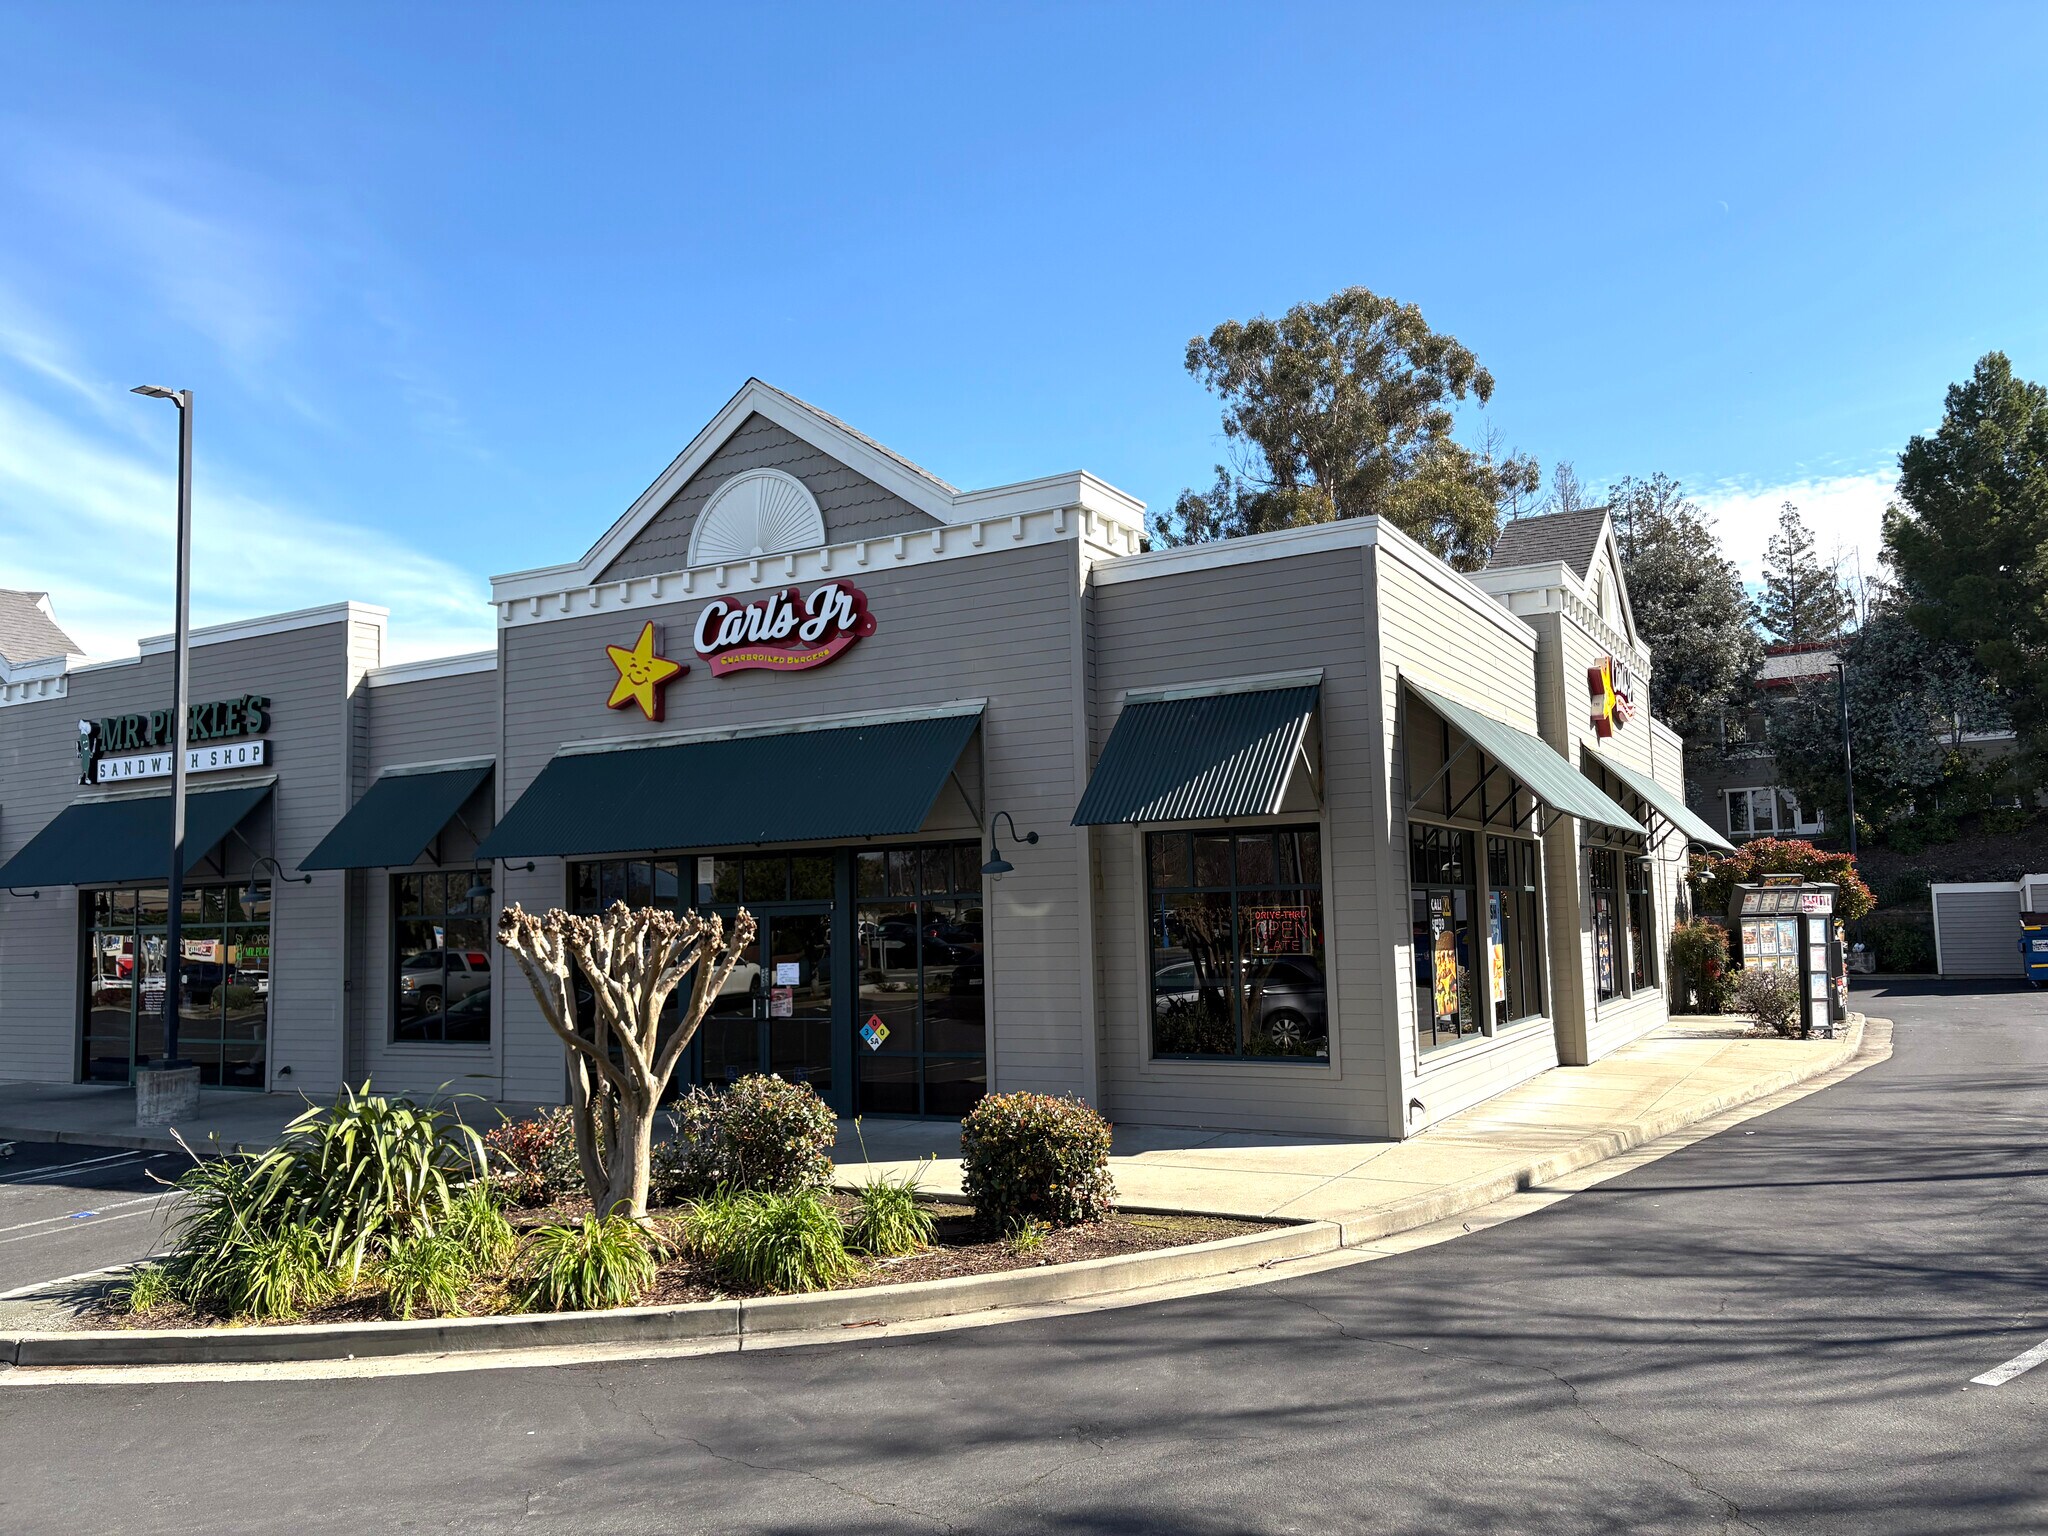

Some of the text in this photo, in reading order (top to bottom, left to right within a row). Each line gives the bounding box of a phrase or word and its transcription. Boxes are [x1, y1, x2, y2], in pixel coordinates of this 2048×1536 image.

[693, 583, 857, 654] Carl's Jr
[100, 694, 263, 752] MR. PIKLE'S
[100, 745, 260, 778] SANDWIH SHOP
[1255, 910, 1307, 919] DRIVE-THRU
[1256, 921, 1309, 939] OPEN
[1265, 940, 1300, 951] LATE
[872, 1019, 877, 1027] 0
[864, 1028, 885, 1036] 3 0
[870, 1037, 880, 1045] SA
